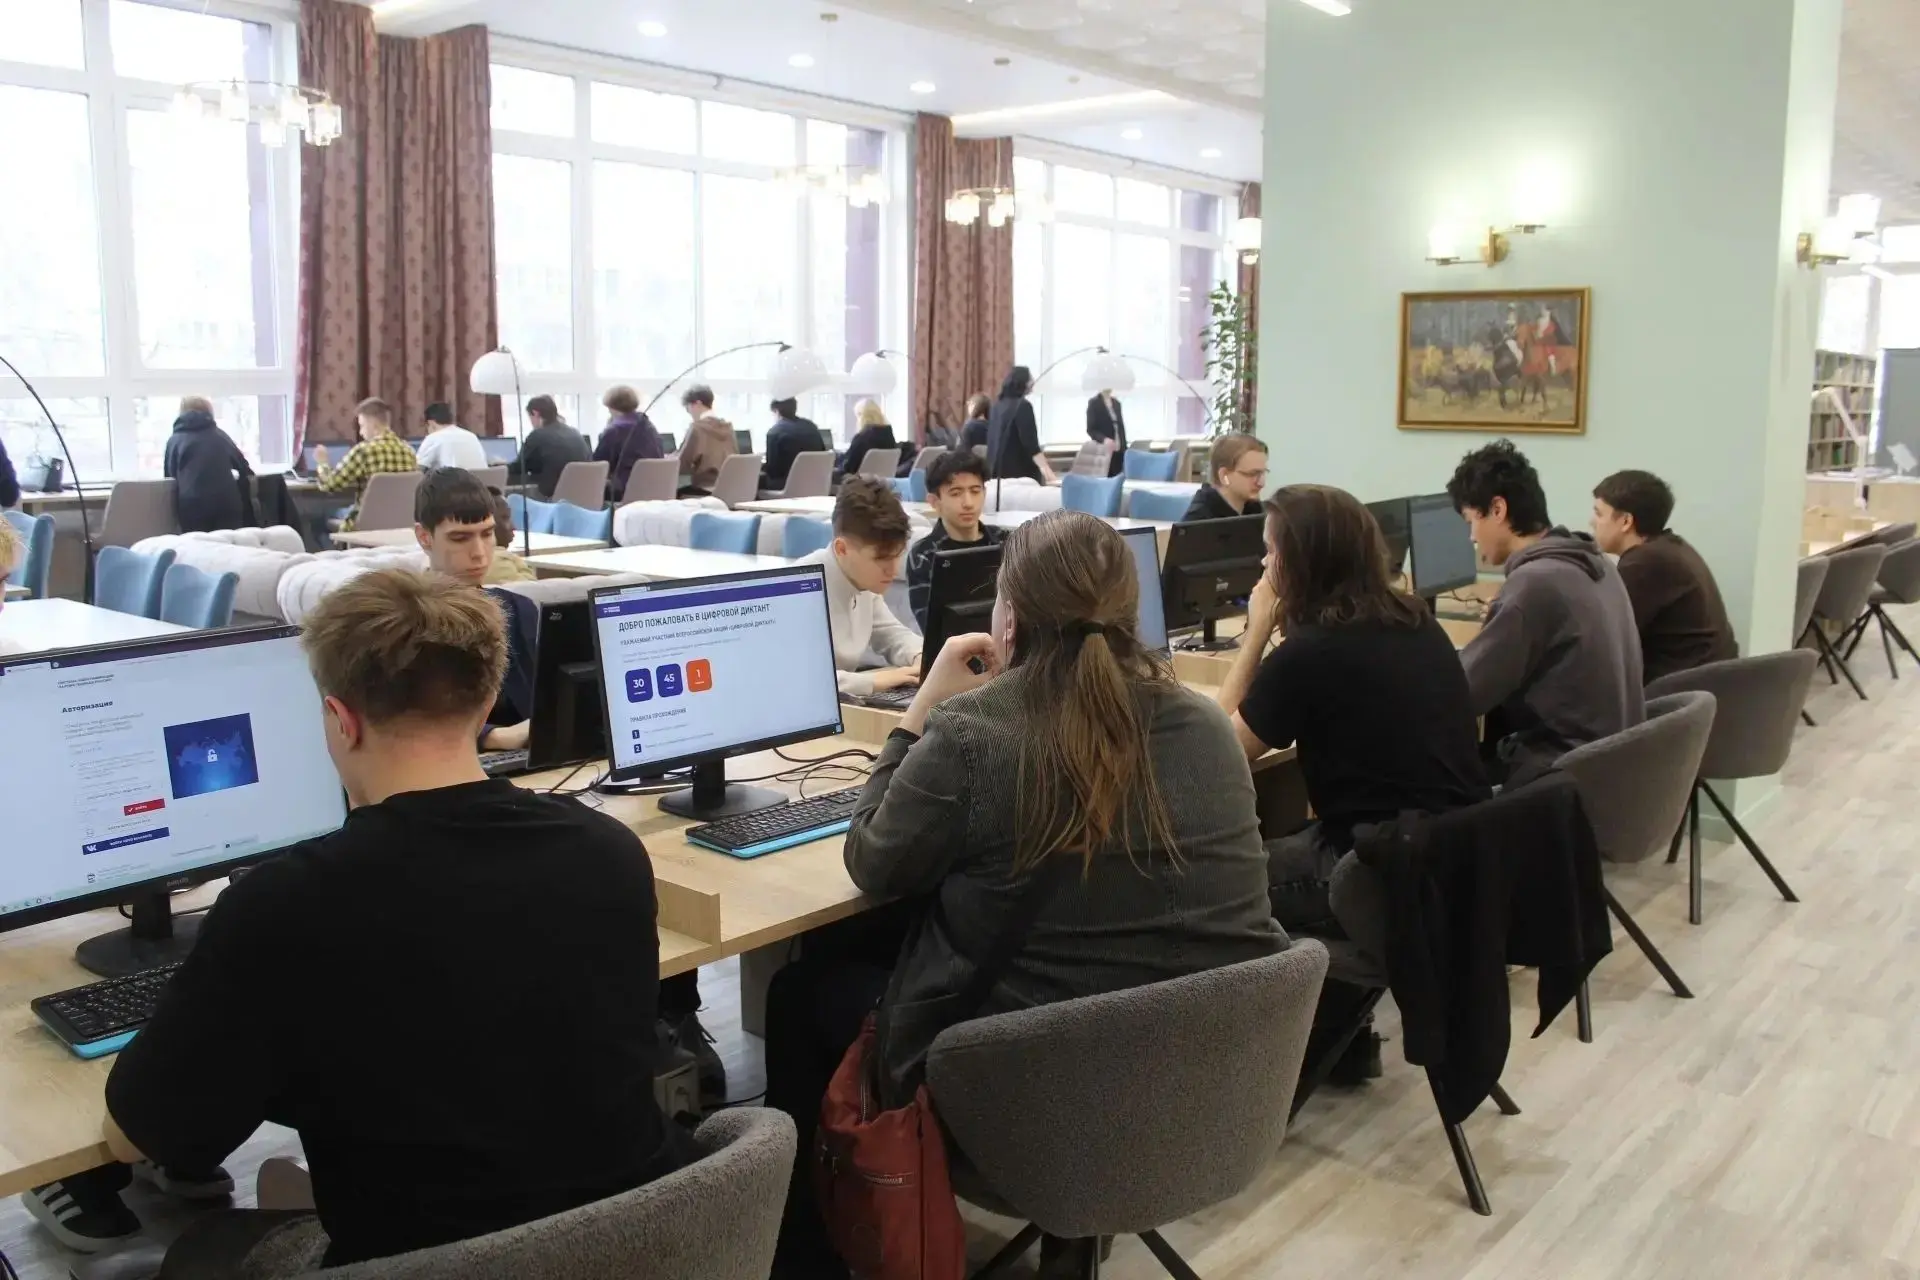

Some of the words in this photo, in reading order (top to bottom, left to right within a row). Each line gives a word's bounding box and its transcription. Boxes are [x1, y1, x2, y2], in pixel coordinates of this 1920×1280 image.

[619, 620, 644, 633] ДОБРО
[645, 613, 694, 628] ПОЖАЛОВАТЬ
[695, 612, 701, 621] В
[702, 607, 739, 621] ЦИФРОВОЙ
[740, 603, 770, 616] ДИКТАНТ
[663, 673, 675, 683] 45
[696, 669, 701, 678] 1
[632, 678, 645, 689] 30
[62, 700, 113, 714] Авторизация
